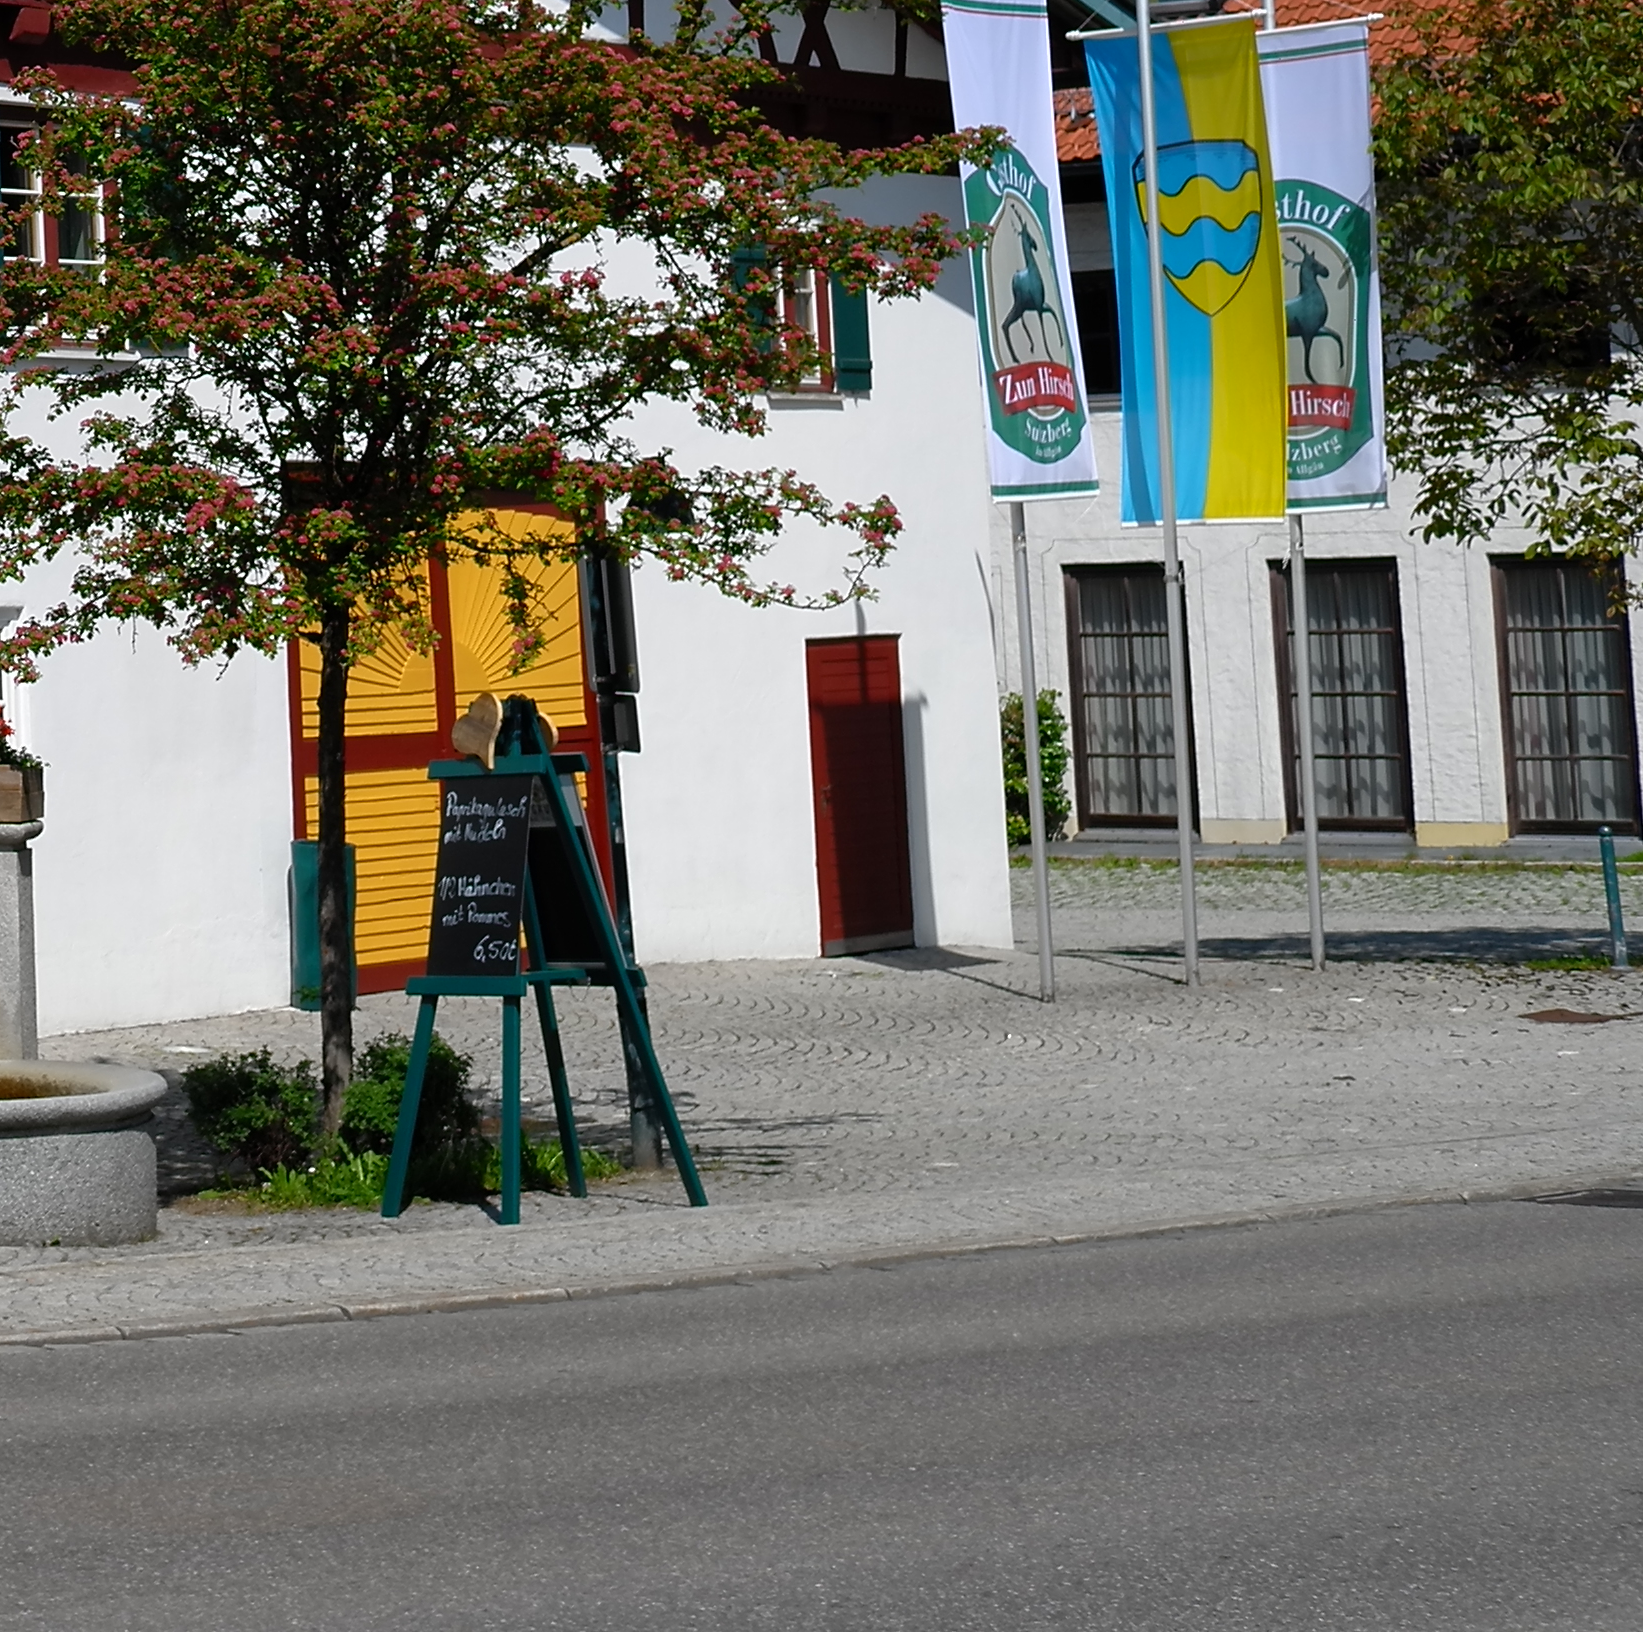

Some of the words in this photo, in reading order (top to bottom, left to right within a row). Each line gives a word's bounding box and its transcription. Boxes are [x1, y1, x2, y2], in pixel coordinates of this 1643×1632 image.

[1274, 188, 1351, 230] sthof
[1037, 366, 1075, 401] Hirsch
[1289, 389, 1351, 419] Hirsch
[1024, 416, 1073, 444] Suzberg
[1286, 433, 1343, 462] lzberg
[441, 903, 464, 927] mit
[466, 900, 512, 928] Pommes
